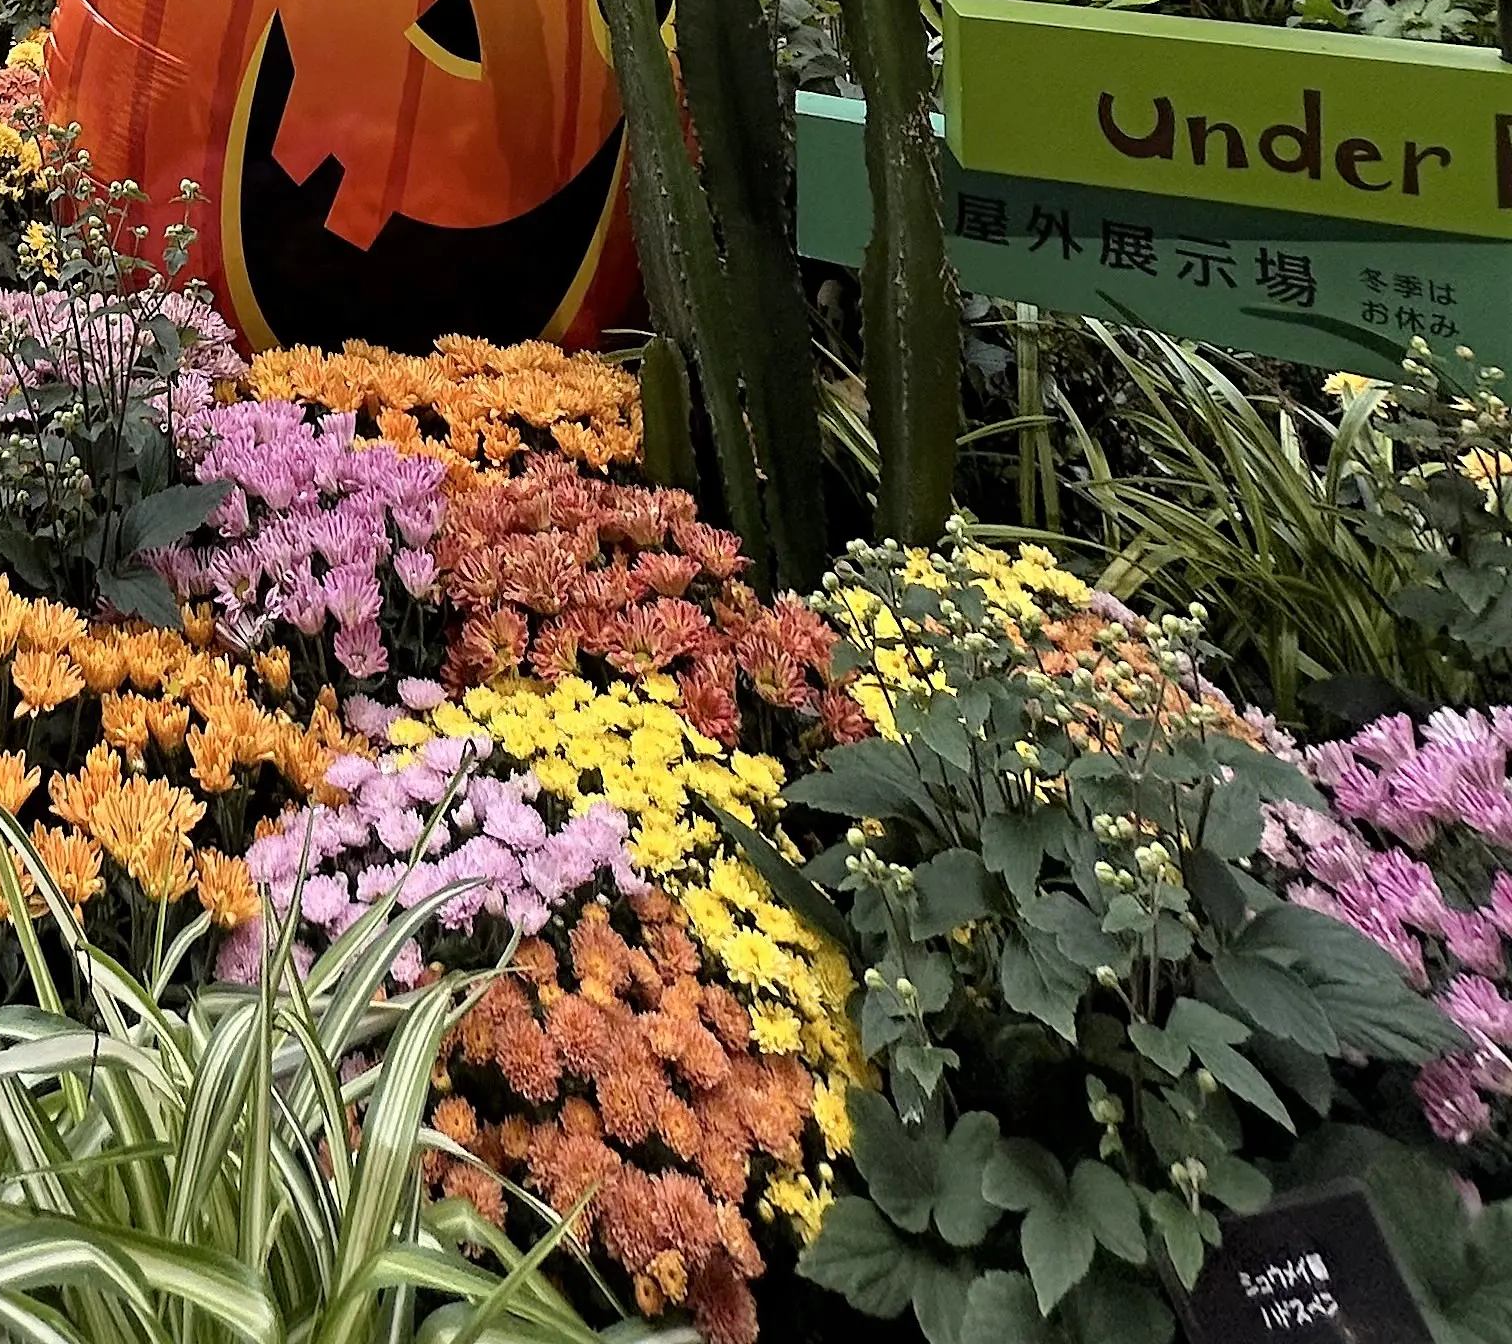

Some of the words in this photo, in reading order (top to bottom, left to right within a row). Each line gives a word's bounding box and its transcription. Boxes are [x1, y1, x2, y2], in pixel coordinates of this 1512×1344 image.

[954, 191, 1318, 308] 屋外展示場
[1359, 267, 1457, 306] 冬季は
[1361, 300, 1460, 338] お休み
